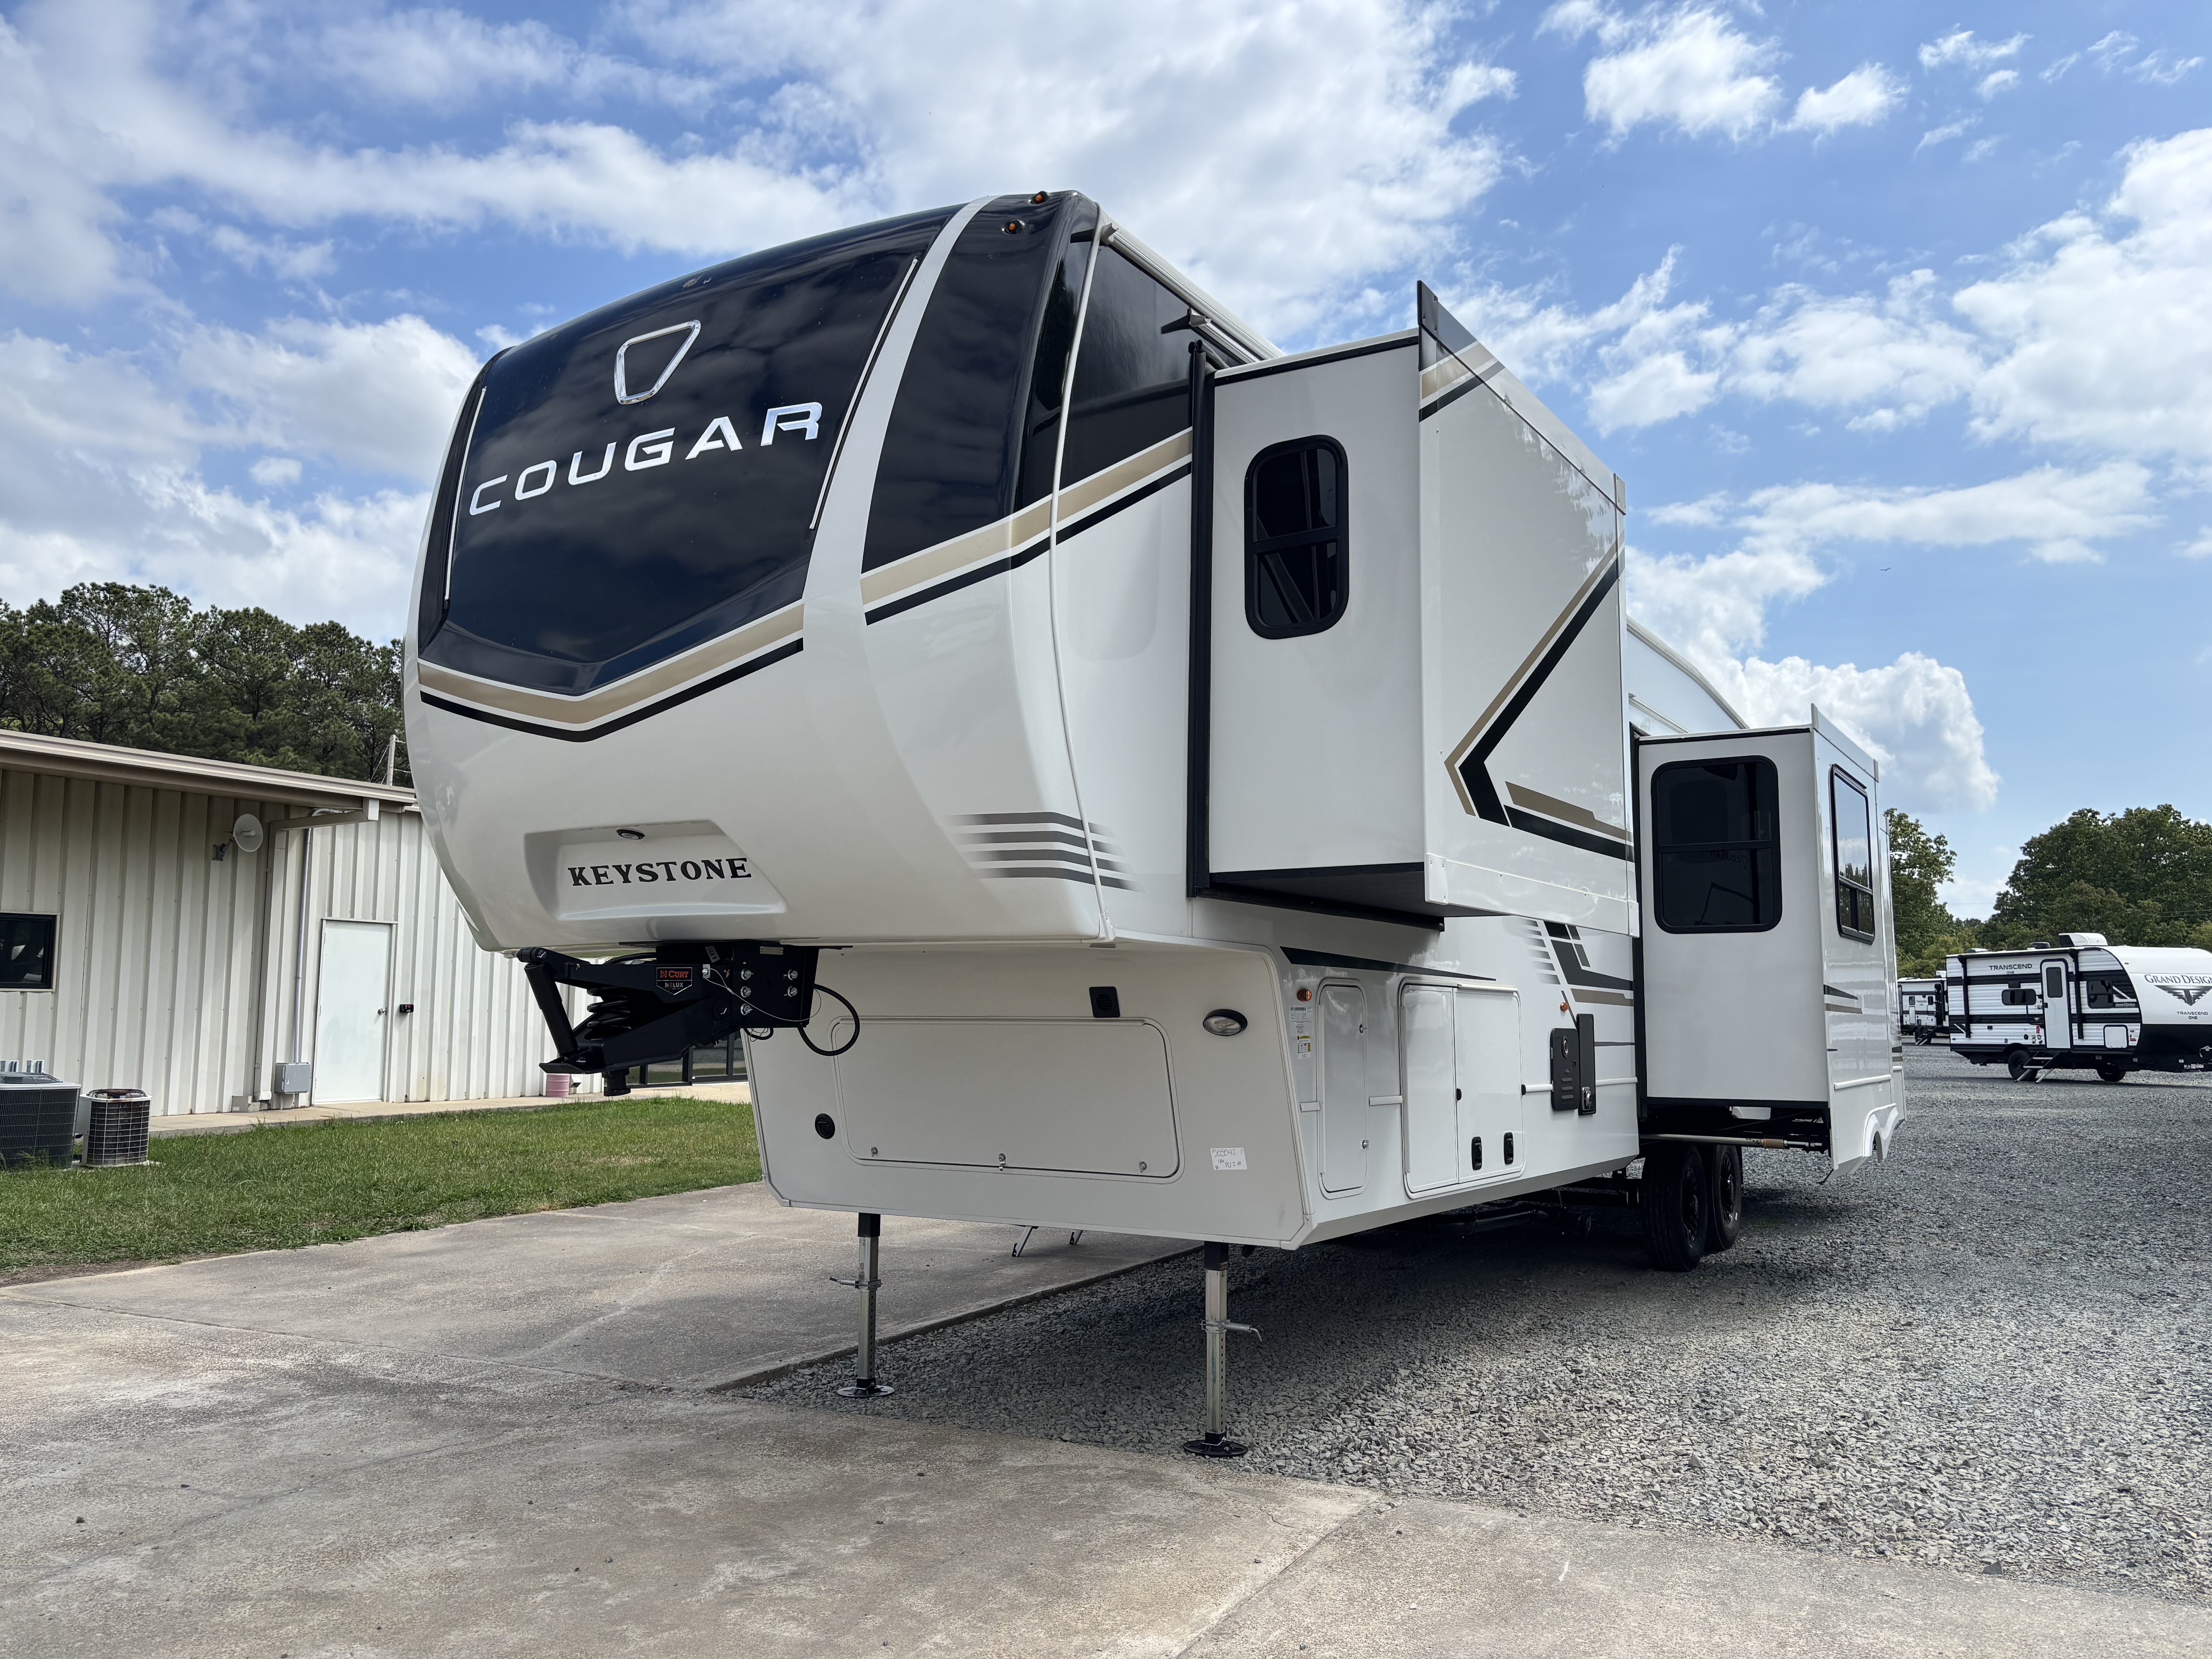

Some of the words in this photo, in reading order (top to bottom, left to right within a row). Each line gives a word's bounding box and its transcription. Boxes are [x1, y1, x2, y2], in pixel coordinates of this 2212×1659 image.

[469, 401, 822, 515] COUGAR
[567, 857, 752, 887] KEYSTONE
[2144, 974, 2181, 983] GRAND
